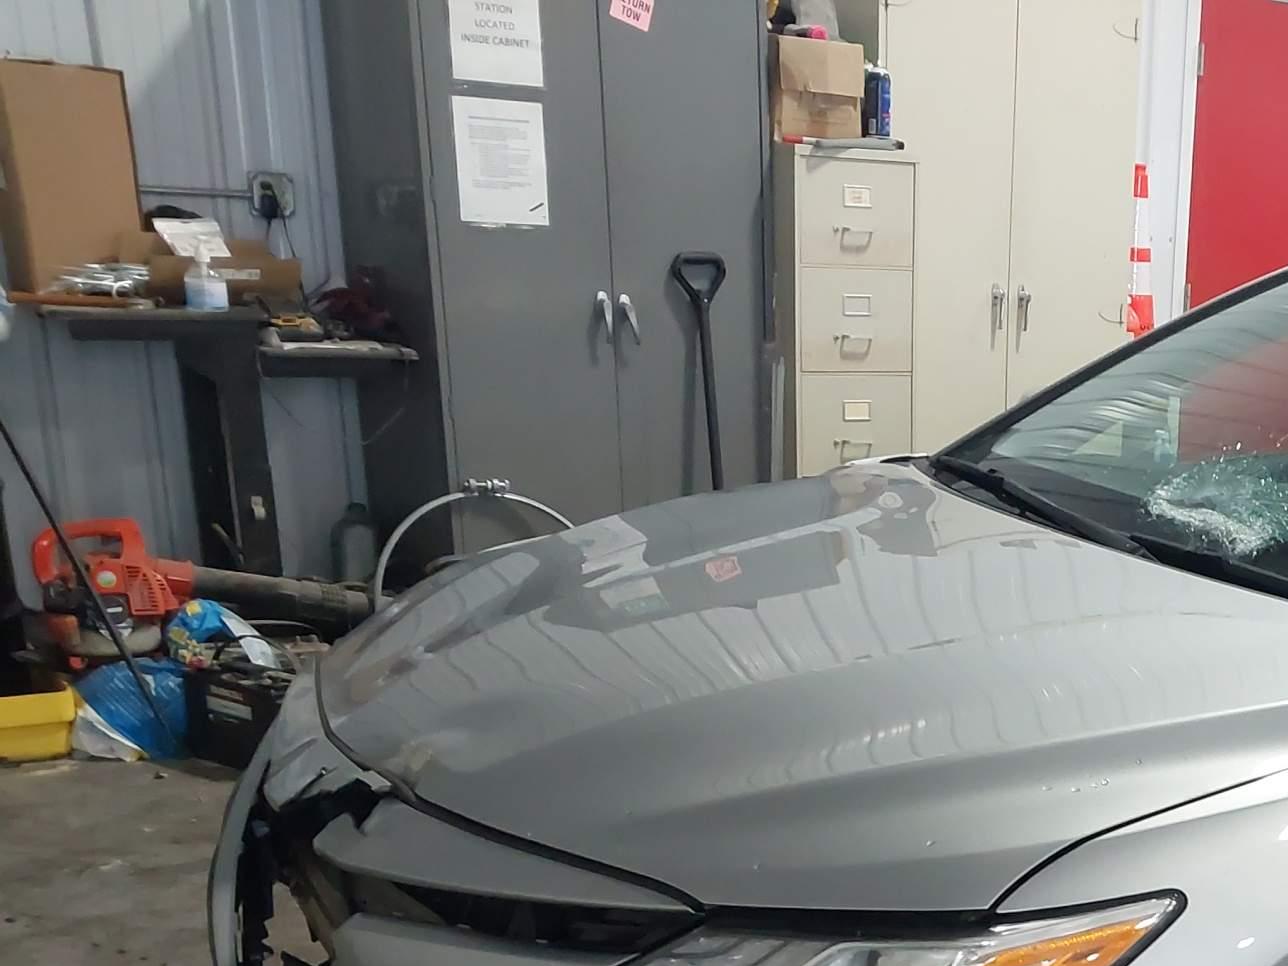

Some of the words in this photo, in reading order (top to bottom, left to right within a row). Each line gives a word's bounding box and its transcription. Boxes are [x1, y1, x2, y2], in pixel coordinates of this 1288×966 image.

[474, 2, 513, 14] STATION
[622, 4, 642, 22] TOW
[474, 19, 516, 31] LOCATED
[460, 33, 491, 45] INSIDE
[492, 36, 530, 48] CABINET
